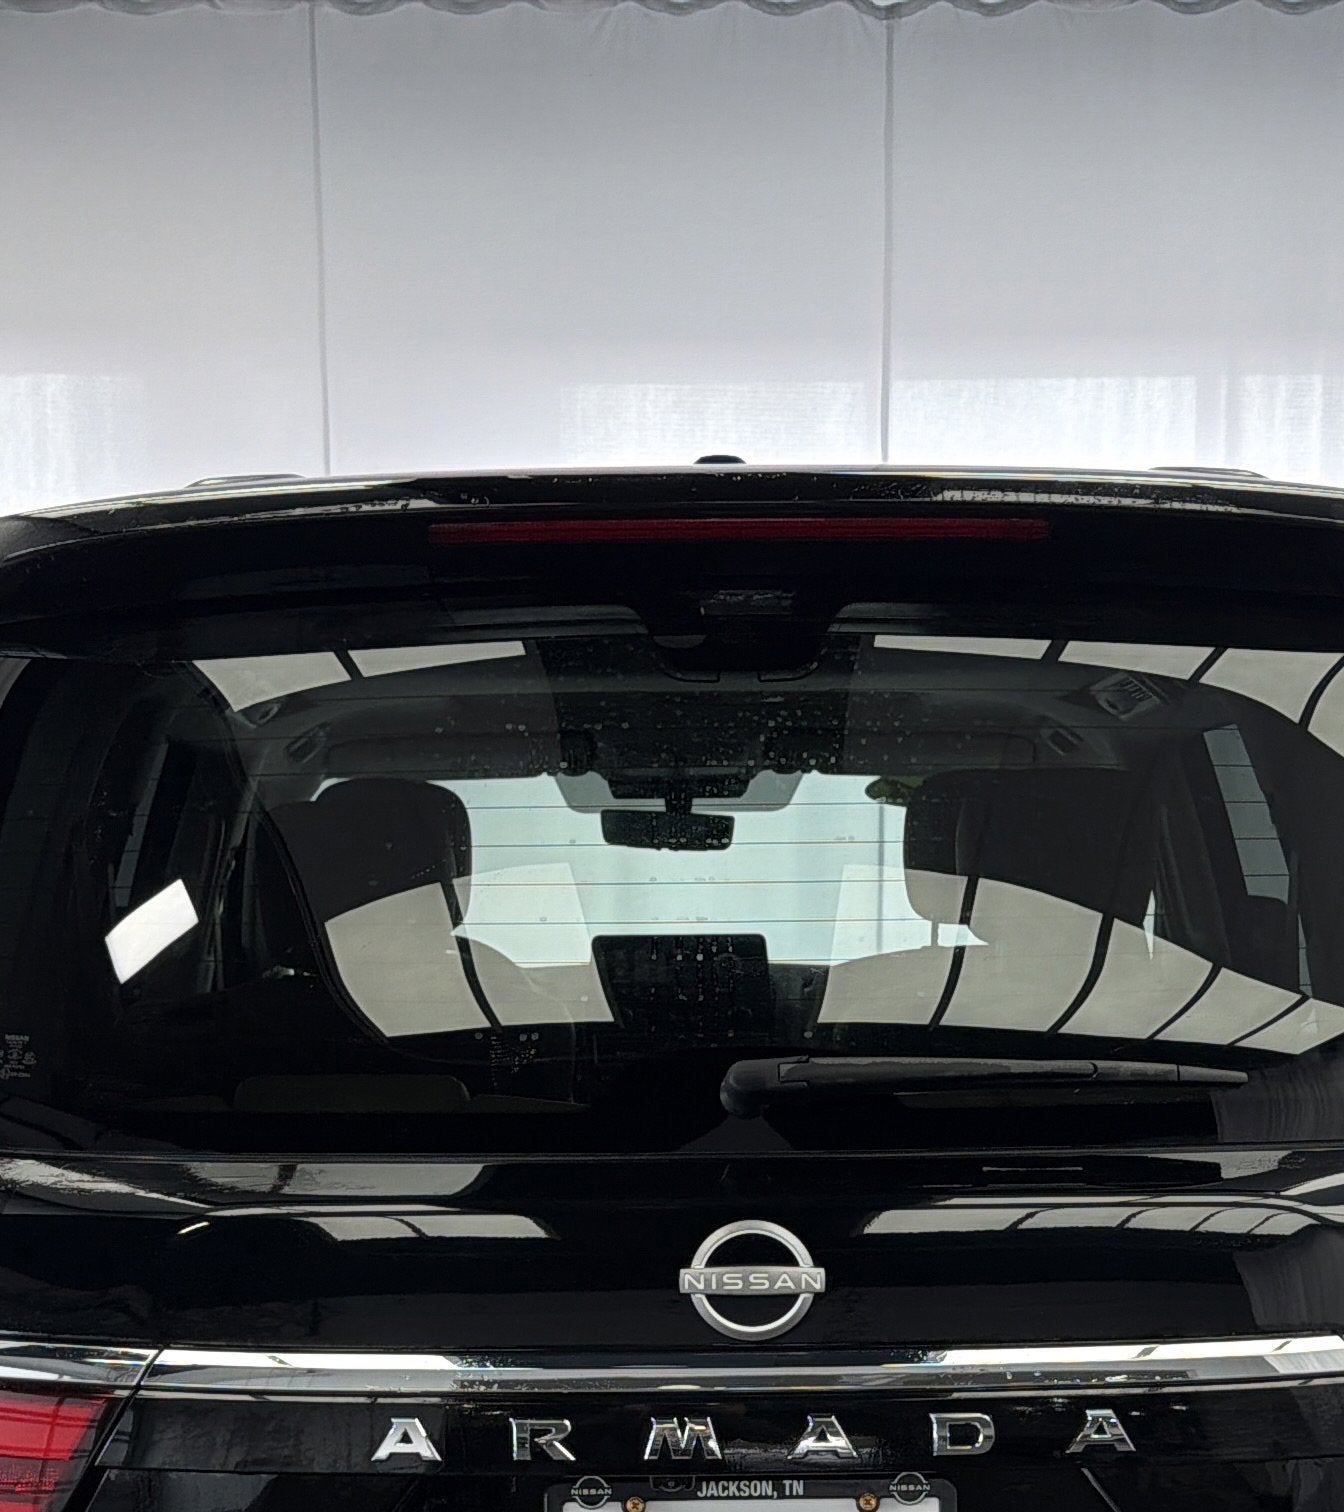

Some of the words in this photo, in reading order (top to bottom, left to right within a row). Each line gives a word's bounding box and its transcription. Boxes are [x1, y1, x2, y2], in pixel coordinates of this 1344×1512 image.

[684, 1273, 822, 1290] NISSAN
[371, 1409, 1136, 1463] ARMADA
[571, 1488, 612, 1496] NISSAN
[697, 1480, 777, 1499] JACKSON,
[782, 1479, 804, 1496] TN
